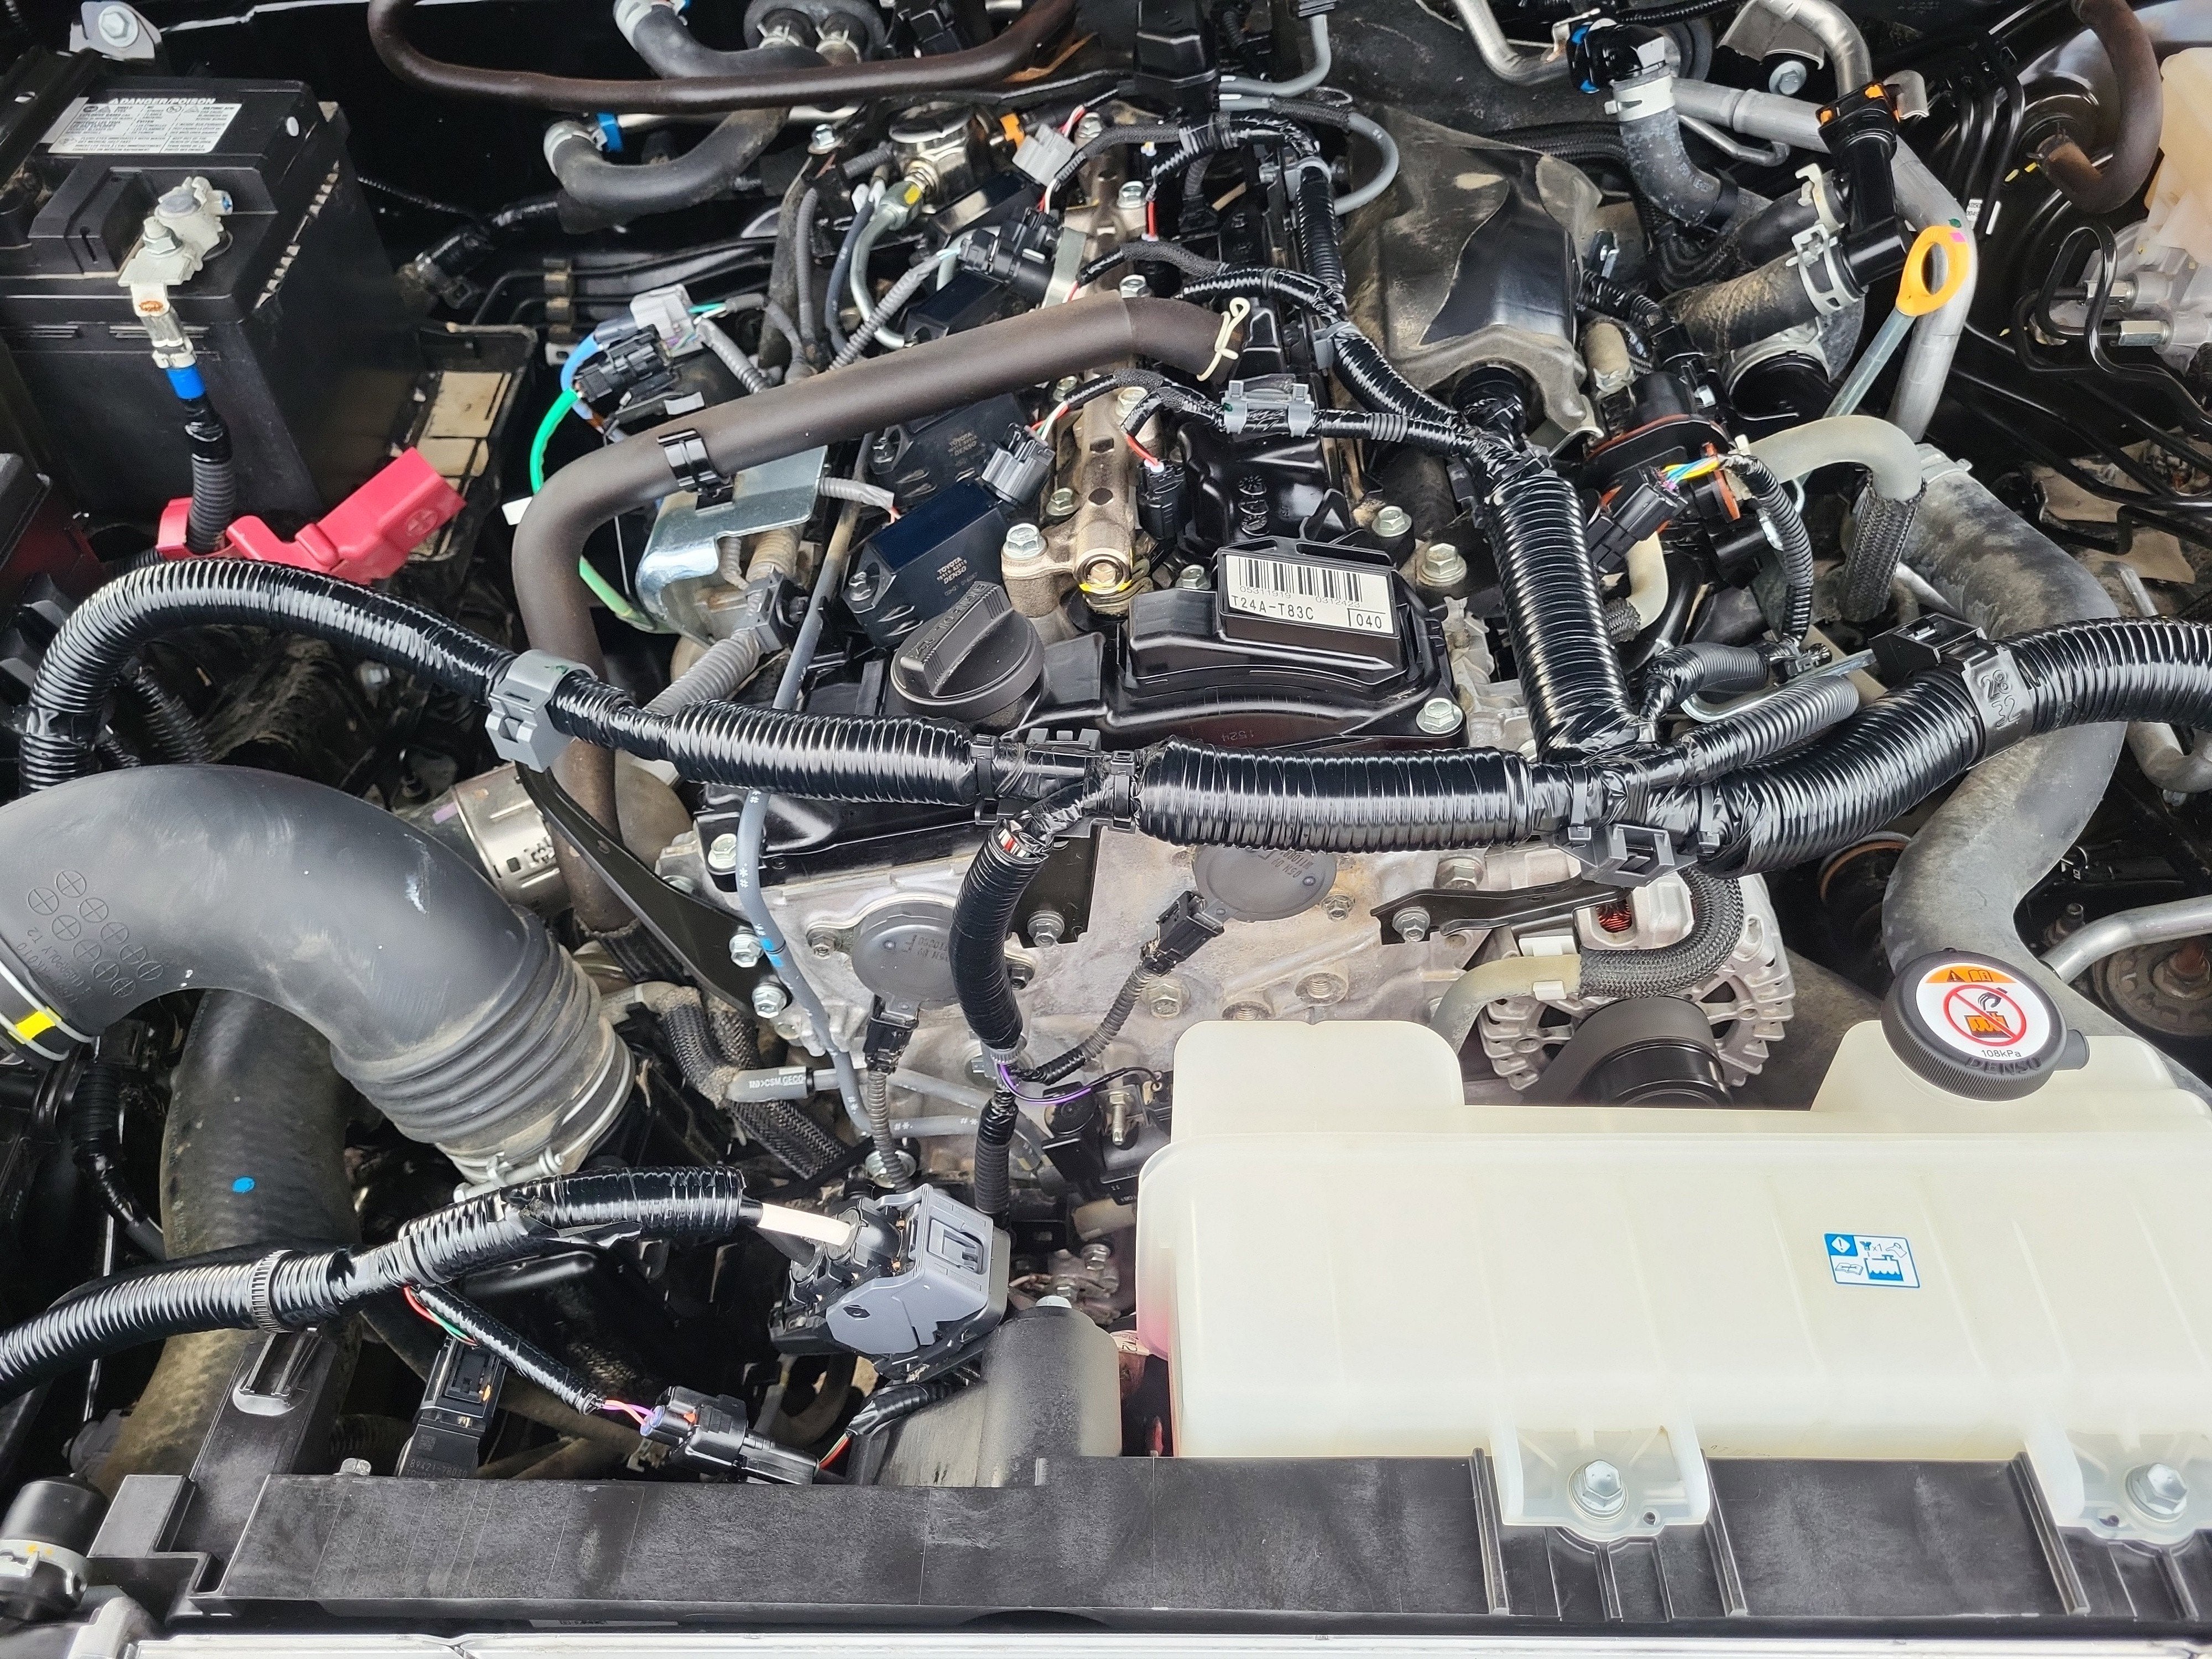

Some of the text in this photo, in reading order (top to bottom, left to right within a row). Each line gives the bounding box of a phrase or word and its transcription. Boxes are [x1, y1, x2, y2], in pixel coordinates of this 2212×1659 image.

[937, 557, 963, 574] TOYOTA
[943, 566, 967, 585] DENSO
[1239, 585, 1361, 608] 05311919 0312423
[1231, 594, 1314, 620] T24A-T83C
[1356, 613, 1383, 629] 040
[1981, 1049, 2022, 1058] 108kPa
[1964, 1056, 2043, 1076] DENSO
